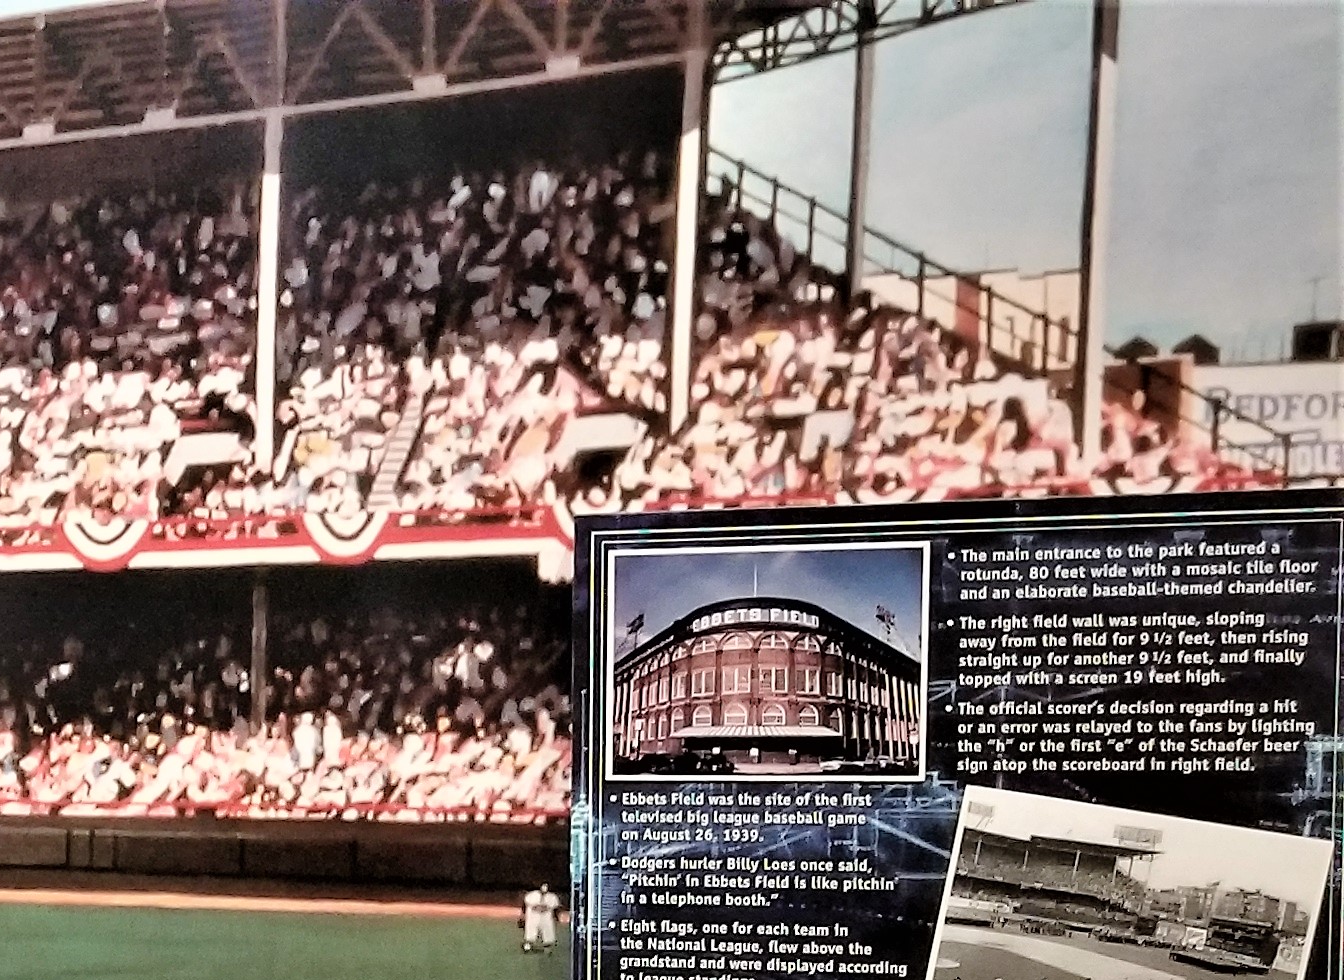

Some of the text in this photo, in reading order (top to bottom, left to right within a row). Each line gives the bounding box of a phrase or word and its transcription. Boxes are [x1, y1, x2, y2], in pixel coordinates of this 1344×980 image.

[960, 540, 1280, 562] The main entrance to the park featured a
[960, 559, 1318, 581] rotunda, 80 feet wide with a mosaic tile floor
[960, 578, 1316, 599] and an elaborate baseball-themed chandelier.
[692, 608, 819, 632] EBBETS FIELD
[957, 698, 1297, 716] The official scorer's decision regarding a hit
[957, 718, 1314, 736] or an error was relayed to the fans by lighting
[957, 739, 981, 752] the
[1019, 741, 1035, 752] or
[1039, 738, 1065, 752] the
[1070, 738, 1101, 752] first
[1138, 737, 1155, 752] of
[1159, 738, 1185, 752] the
[1190, 737, 1259, 751] Schaefer
[1263, 737, 1300, 751] beer
[956, 756, 1255, 774] sign atop the scoreboard in right field.
[622, 791, 871, 806] Ebbets Field was the site of the first
[621, 809, 866, 828] televised big league baseball game
[621, 830, 638, 842] on
[642, 828, 690, 843] August
[723, 828, 763, 842] 1939.
